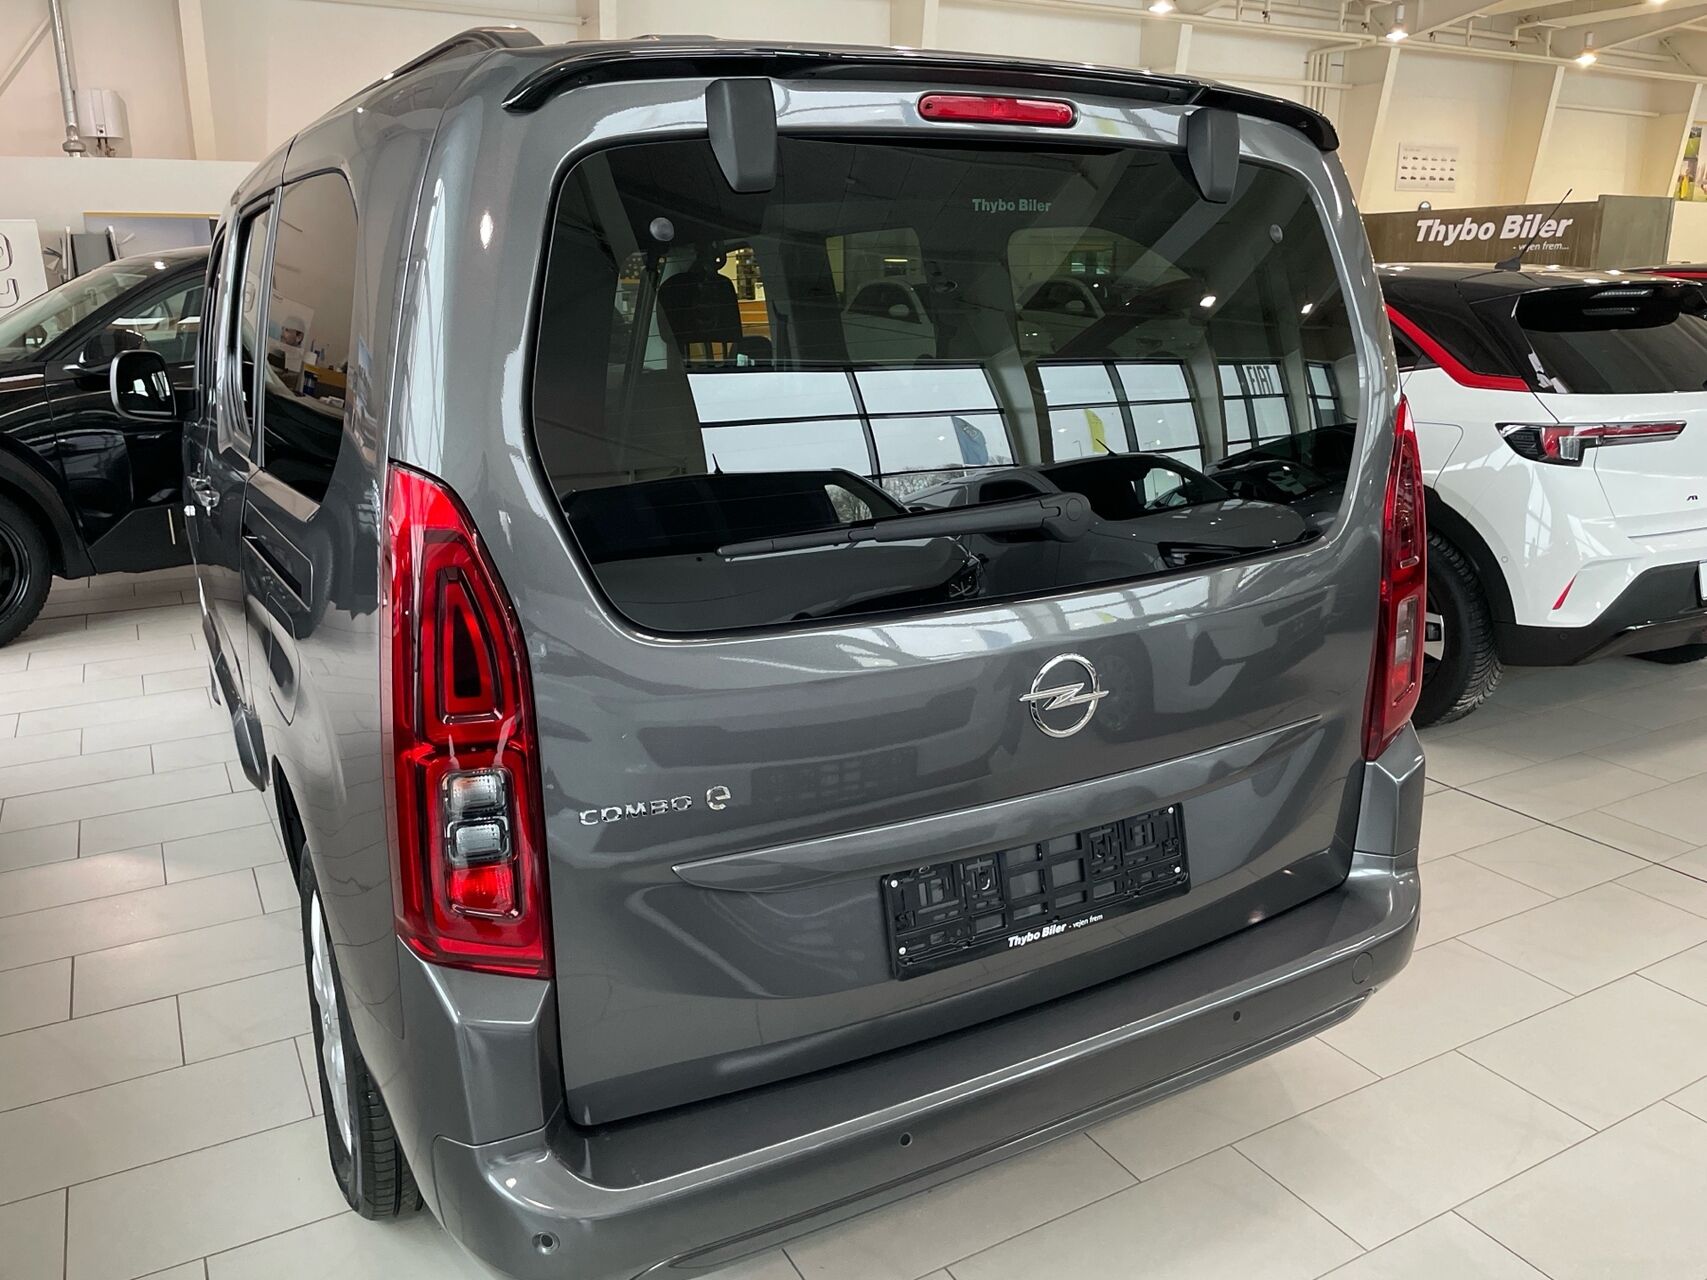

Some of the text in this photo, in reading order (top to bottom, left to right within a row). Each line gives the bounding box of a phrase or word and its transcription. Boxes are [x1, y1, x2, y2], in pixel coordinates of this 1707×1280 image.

[972, 198, 1052, 214] Thybo Biler
[1416, 213, 1573, 246] Thybo Biler
[1245, 365, 1276, 396] FIAT
[579, 795, 692, 826] COMBO
[1007, 931, 1041, 948] Thybo
[1041, 923, 1067, 938] Biler
[1089, 913, 1104, 923] frem
